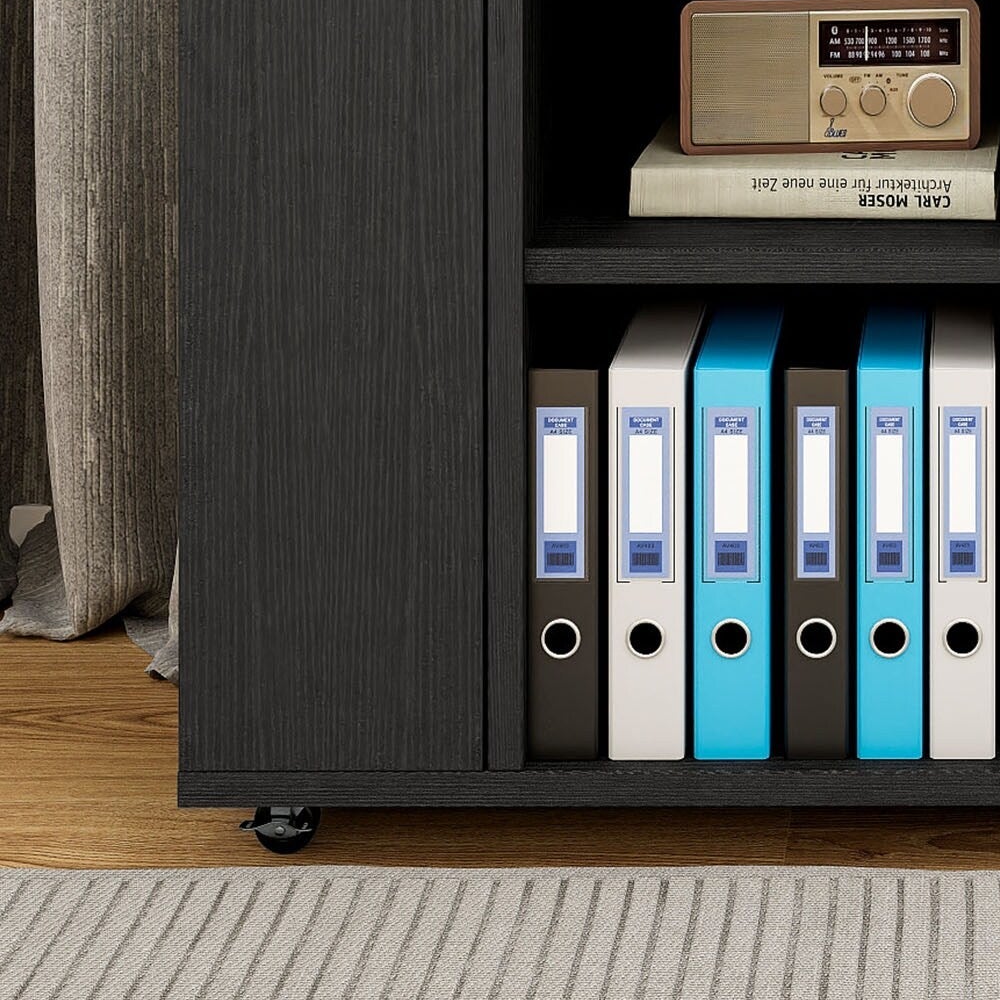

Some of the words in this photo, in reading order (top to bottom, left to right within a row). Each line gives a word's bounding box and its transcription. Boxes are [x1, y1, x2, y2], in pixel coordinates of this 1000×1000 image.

[752, 178, 777, 192] Zeit
[782, 178, 814, 188] neue
[820, 178, 848, 192] eine
[852, 178, 871, 192] für
[876, 178, 952, 192] Architektur
[858, 194, 908, 208] MOSER
[914, 196, 950, 208] CARL
